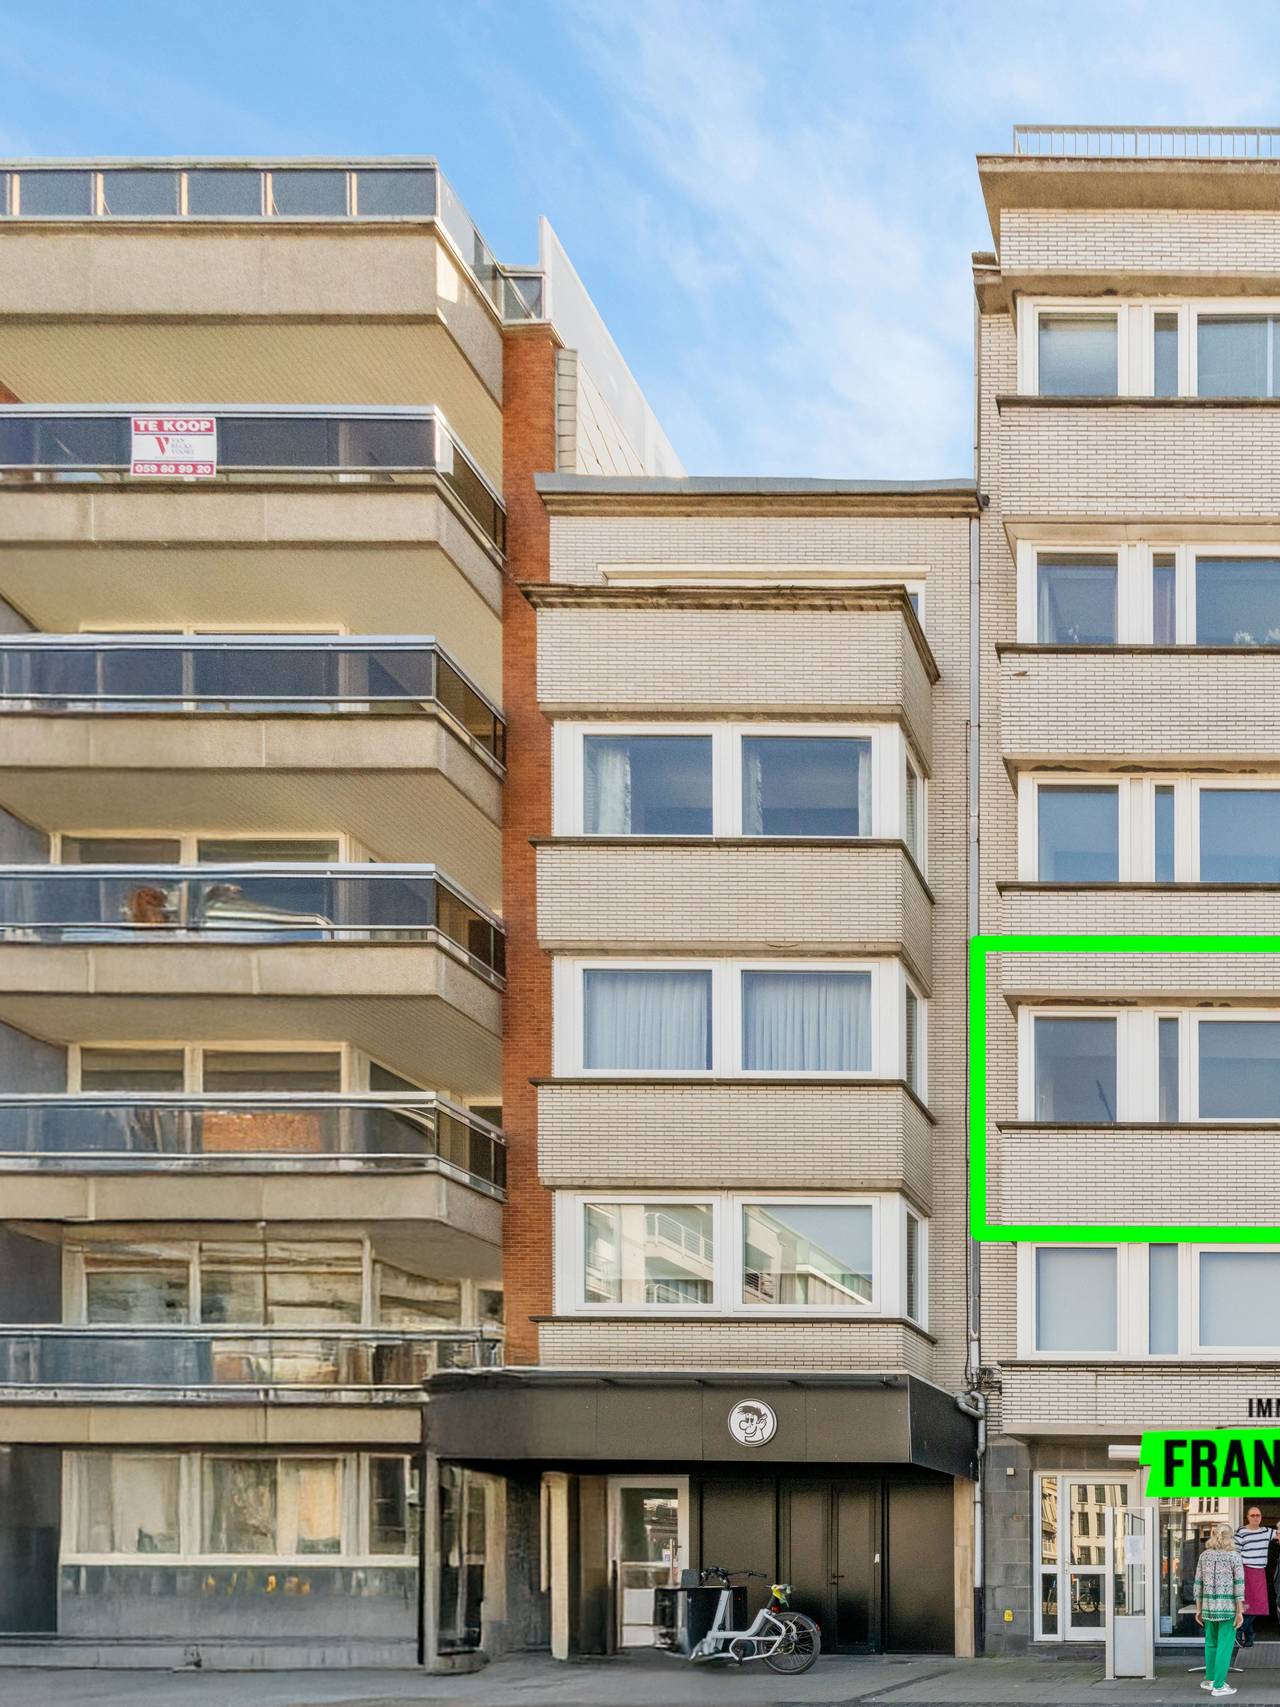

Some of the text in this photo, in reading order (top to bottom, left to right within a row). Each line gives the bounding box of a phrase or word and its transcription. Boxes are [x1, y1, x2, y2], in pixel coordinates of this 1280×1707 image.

[136, 420, 211, 432] TE KOOP
[135, 464, 158, 473] 059
[178, 465, 194, 474] 99
[196, 465, 212, 474] 20
